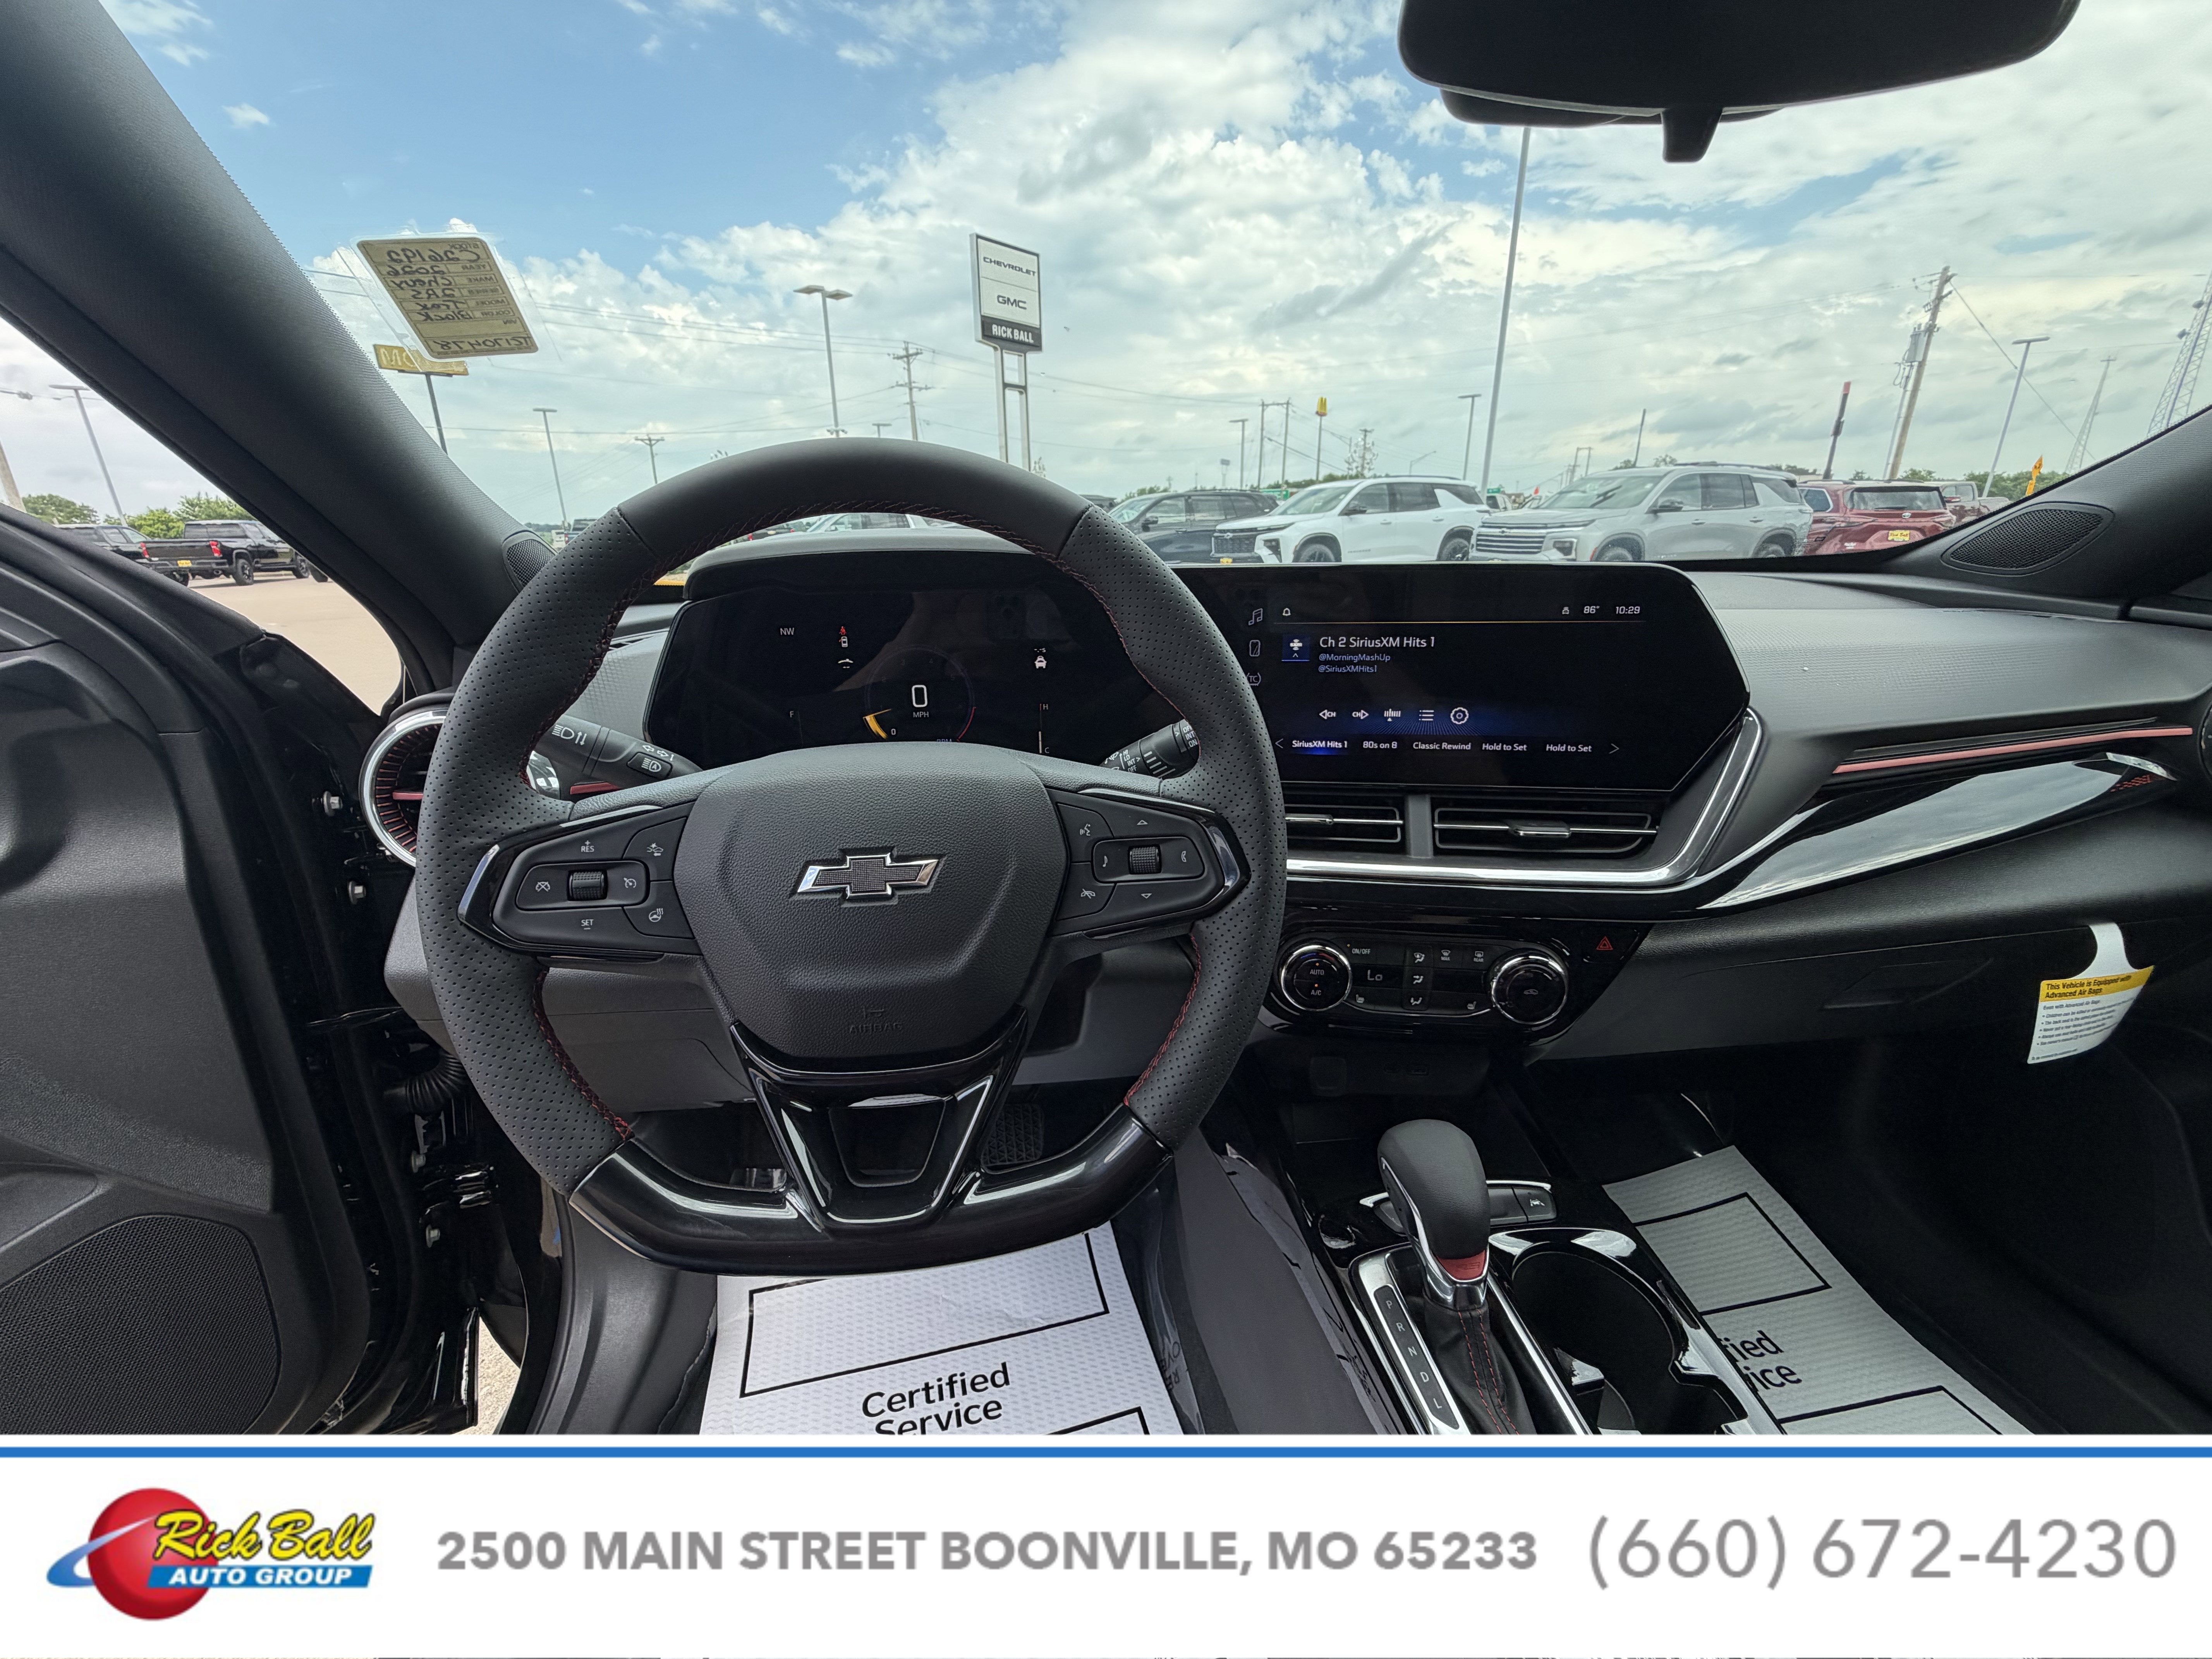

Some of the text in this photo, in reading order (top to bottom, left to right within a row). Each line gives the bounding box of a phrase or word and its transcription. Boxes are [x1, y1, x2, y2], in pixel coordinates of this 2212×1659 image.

[983, 256, 1036, 276] CHEVROLET
[997, 295, 1027, 310] GMC
[992, 324, 1034, 343] RICK BALL
[1616, 606, 1640, 614] 10:29
[780, 627, 795, 635] NW
[1319, 636, 1435, 647] Ch 2 SiriusXM Hits 1
[1318, 653, 1391, 663] @MorningMashUp
[1318, 665, 1377, 673] @SiriusXMHits1
[911, 684, 928, 708] 0
[1185, 731, 1195, 740] INT
[1188, 738, 1198, 748] ON
[1292, 740, 1326, 748] SiriusXM
[1327, 740, 1342, 748] Hits
[1413, 741, 1472, 750] Classic Rewind
[1546, 744, 1566, 752] Hold
[1577, 744, 1592, 752] Set
[1367, 969, 1383, 981] Lo
[2062, 981, 2085, 989] Vehicle
[2093, 978, 2119, 987] Equipped
[2045, 990, 2077, 998] Advanced
[2087, 988, 2103, 996] Bags
[1386, 1300, 1393, 1309] P
[1396, 1322, 1405, 1332] R
[1408, 1346, 1417, 1357] N
[1420, 1372, 1429, 1382] D
[862, 1361, 1010, 1417] Certified
[1433, 1398, 1443, 1409] L
[875, 1400, 1002, 1436] Service
